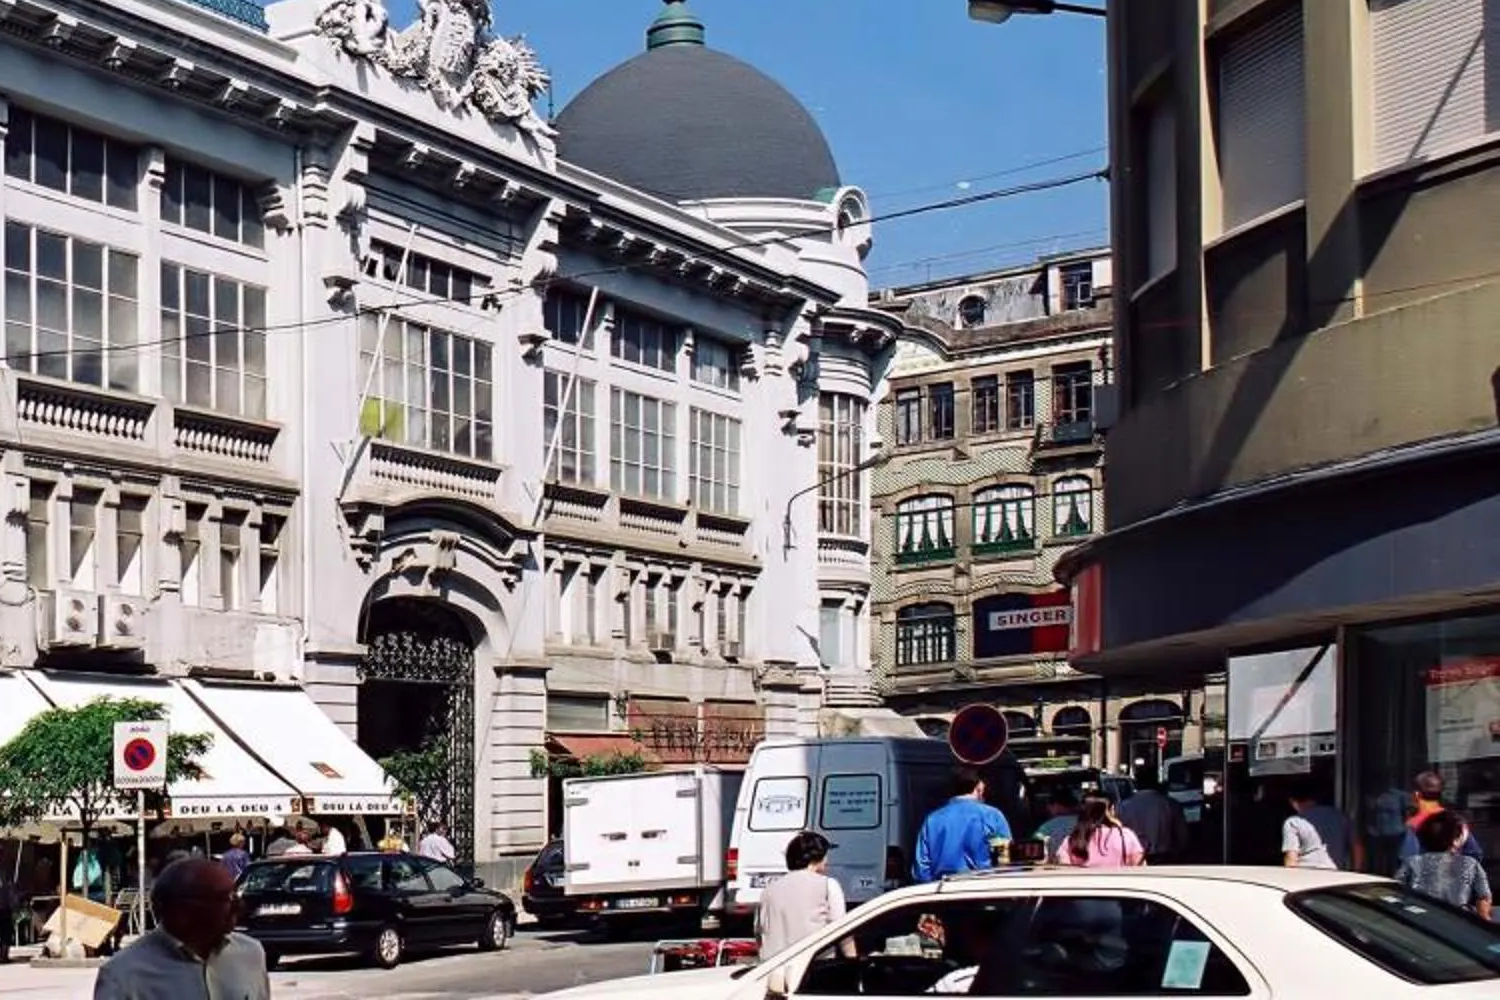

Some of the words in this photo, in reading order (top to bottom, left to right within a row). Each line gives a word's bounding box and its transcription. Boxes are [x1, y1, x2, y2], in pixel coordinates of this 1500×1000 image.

[997, 609, 1067, 626] SINGER
[180, 804, 211, 815] DEU
[241, 803, 269, 813] DEU
[322, 802, 345, 811] DEU
[367, 802, 389, 811] DEU
